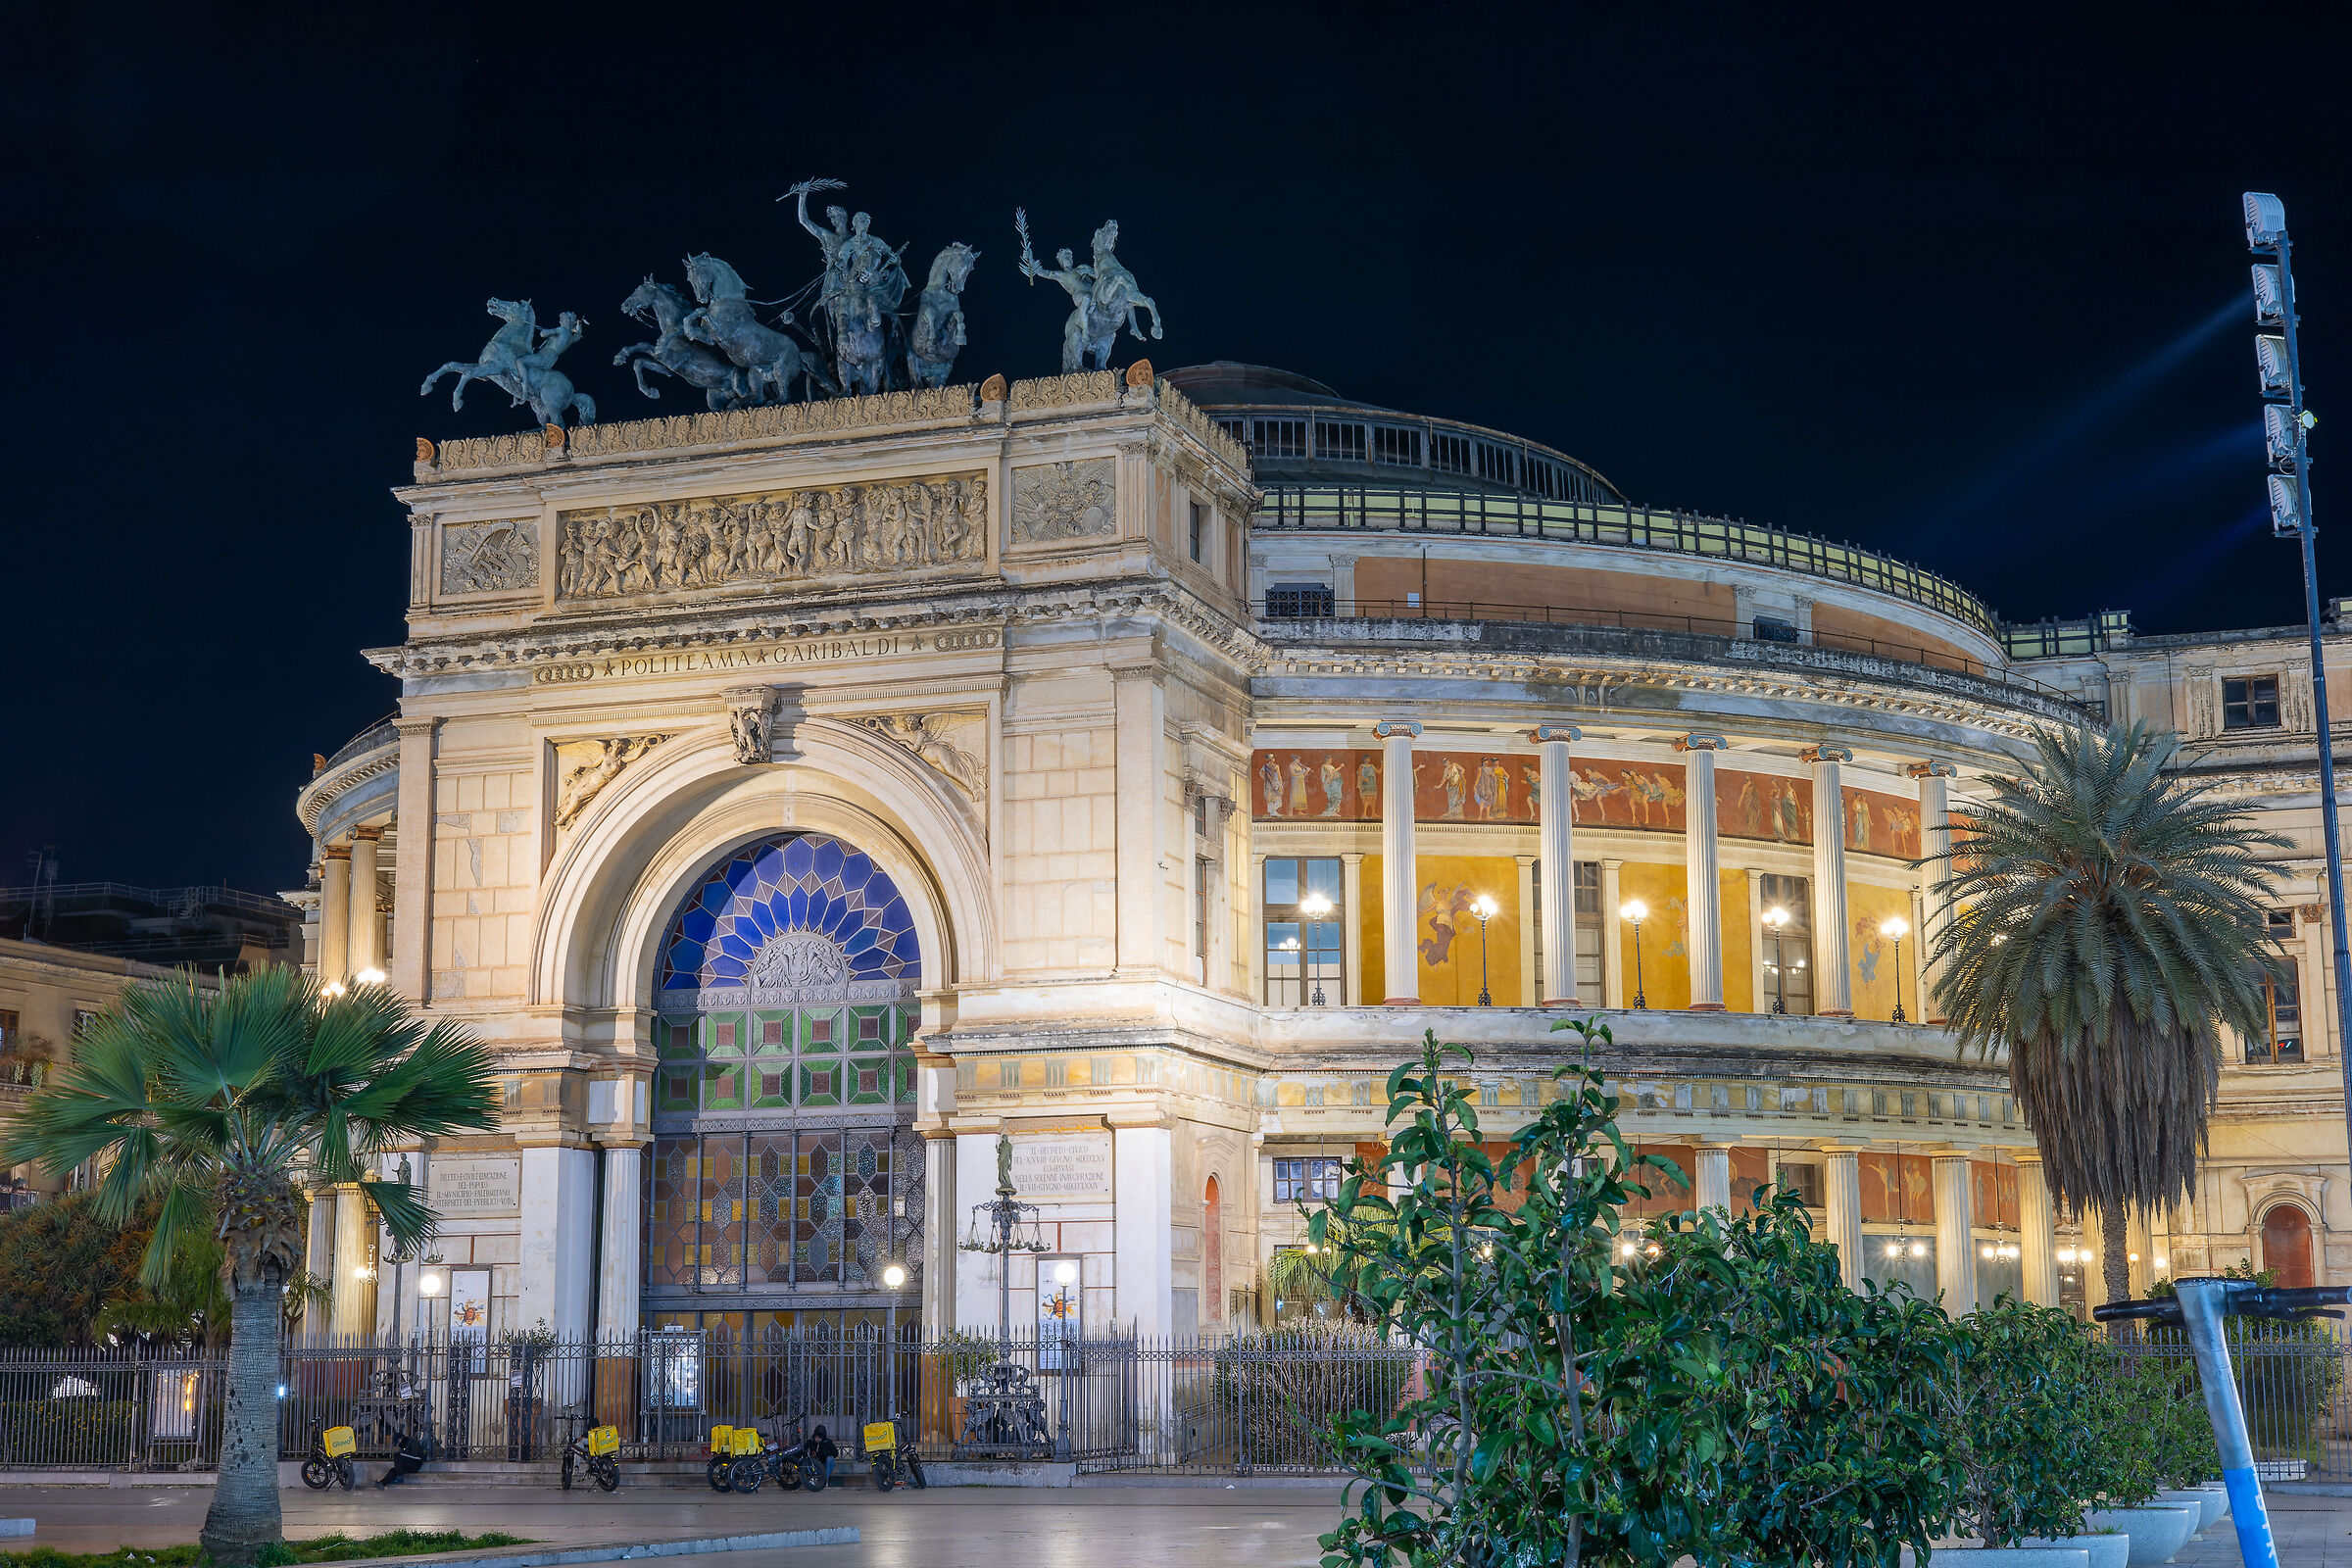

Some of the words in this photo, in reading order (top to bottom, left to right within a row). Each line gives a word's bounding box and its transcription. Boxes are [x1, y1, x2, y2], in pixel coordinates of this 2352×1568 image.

[620, 650, 751, 676] POLITEAMA
[773, 637, 899, 663] GARIBALDI
[333, 1438, 352, 1447] Glovo
